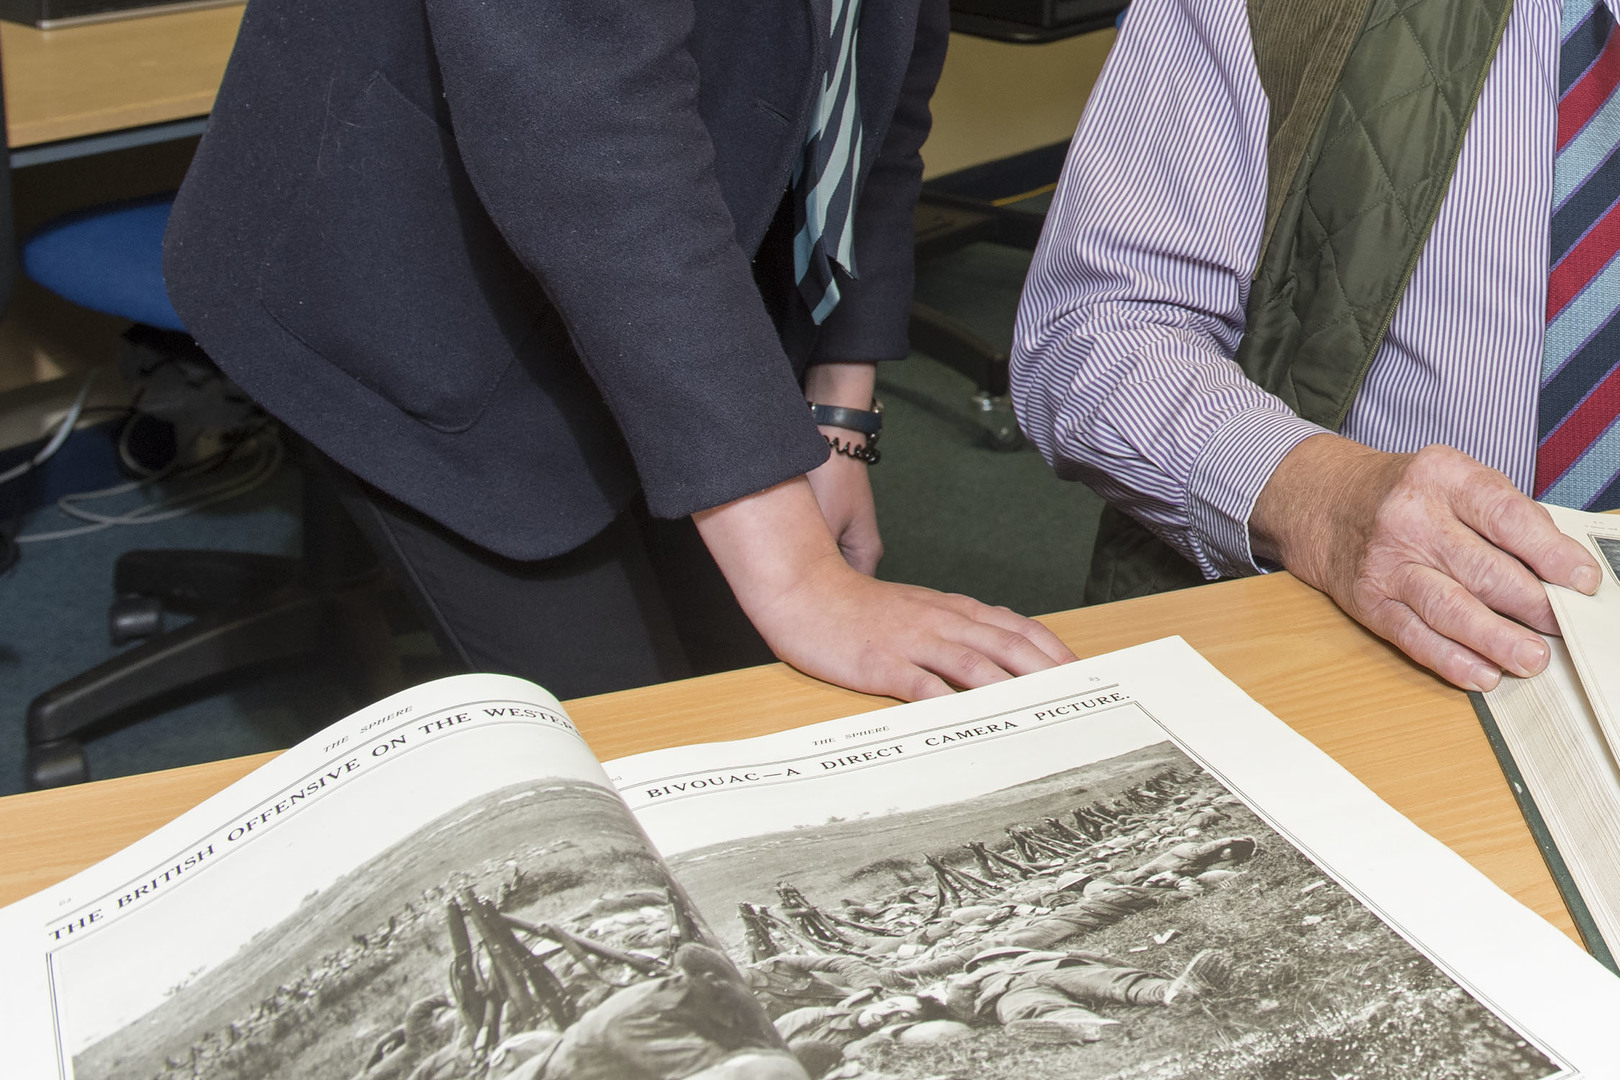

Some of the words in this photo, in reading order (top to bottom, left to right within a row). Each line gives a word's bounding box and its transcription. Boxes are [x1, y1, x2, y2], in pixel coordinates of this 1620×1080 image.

[323, 735, 350, 754] THE
[360, 705, 414, 734] SPHERE
[811, 737, 837, 747] THE
[844, 725, 891, 740] SPHERE
[820, 744, 905, 770] DIRECT
[925, 720, 1019, 747] CAMERA
[1034, 692, 1131, 721] PICTURE.
[48, 908, 105, 941] THE
[117, 843, 215, 909] BRITISH
[227, 758, 361, 842] OFFENSIVE
[371, 734, 408, 758] ON
[418, 712, 472, 735] THE
